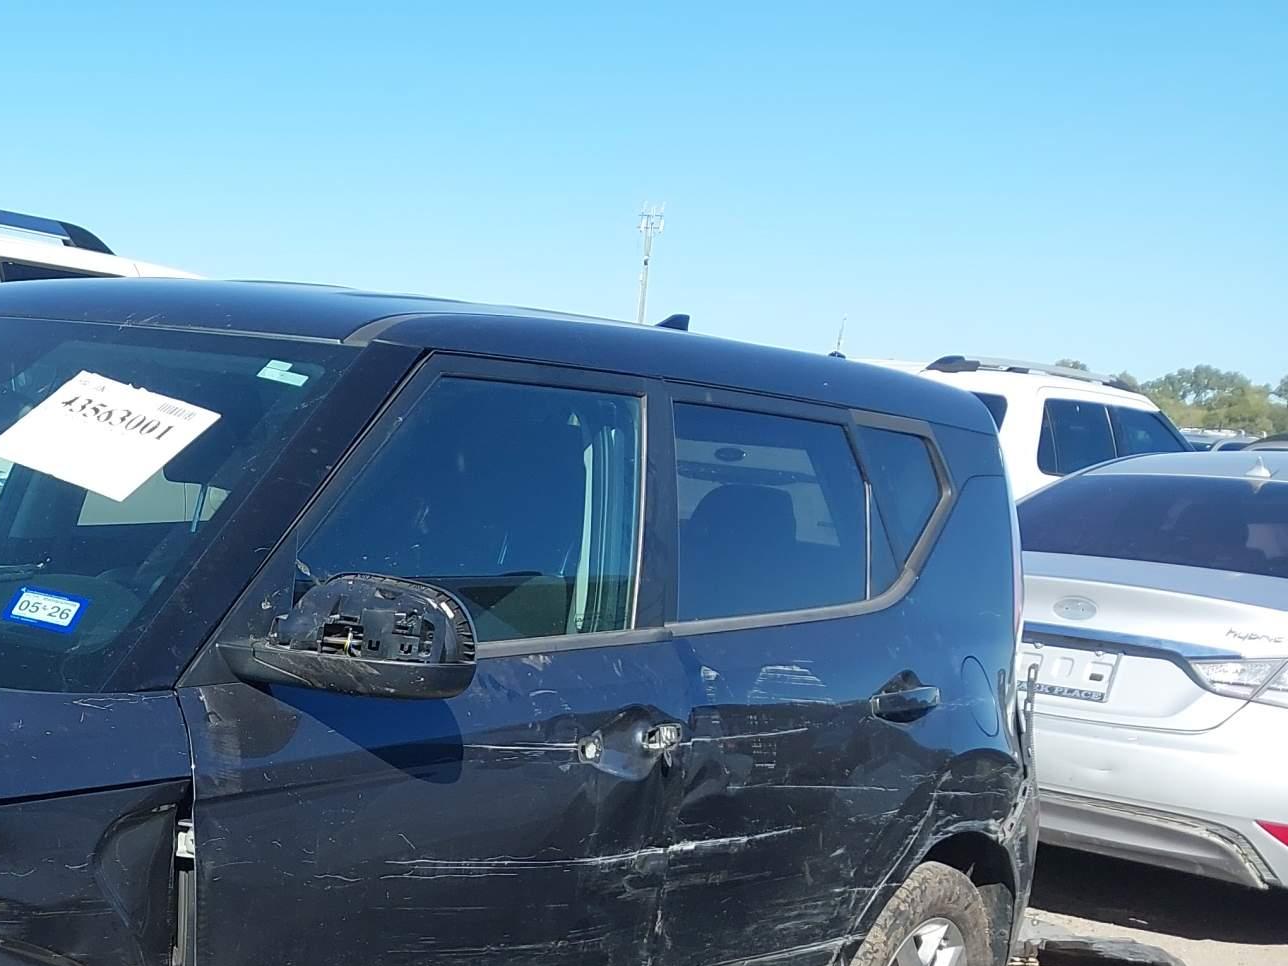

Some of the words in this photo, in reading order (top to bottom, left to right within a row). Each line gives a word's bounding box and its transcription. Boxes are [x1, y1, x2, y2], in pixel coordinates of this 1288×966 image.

[61, 395, 176, 441] 43563001
[18, 599, 41, 613] 05
[47, 605, 72, 620] 26
[1053, 686, 1102, 700] PLACE
